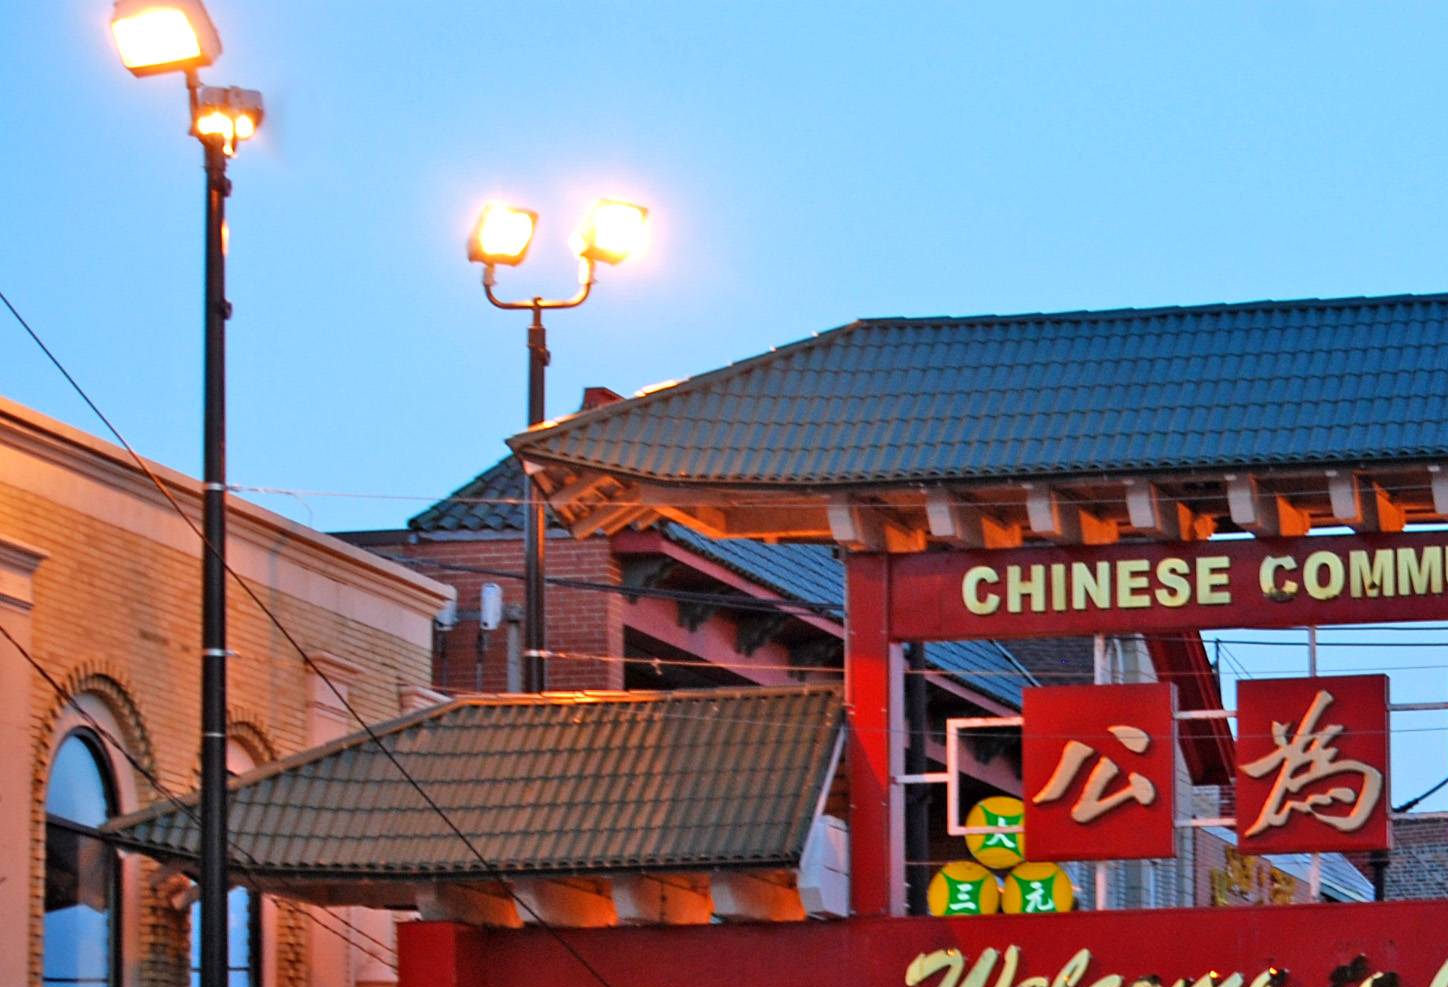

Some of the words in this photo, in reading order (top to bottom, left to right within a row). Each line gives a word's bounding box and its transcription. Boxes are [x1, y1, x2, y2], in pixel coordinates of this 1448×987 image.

[963, 556, 1231, 615] CHINESE
[1033, 725, 1155, 823] 公
[1238, 690, 1383, 837] 為
